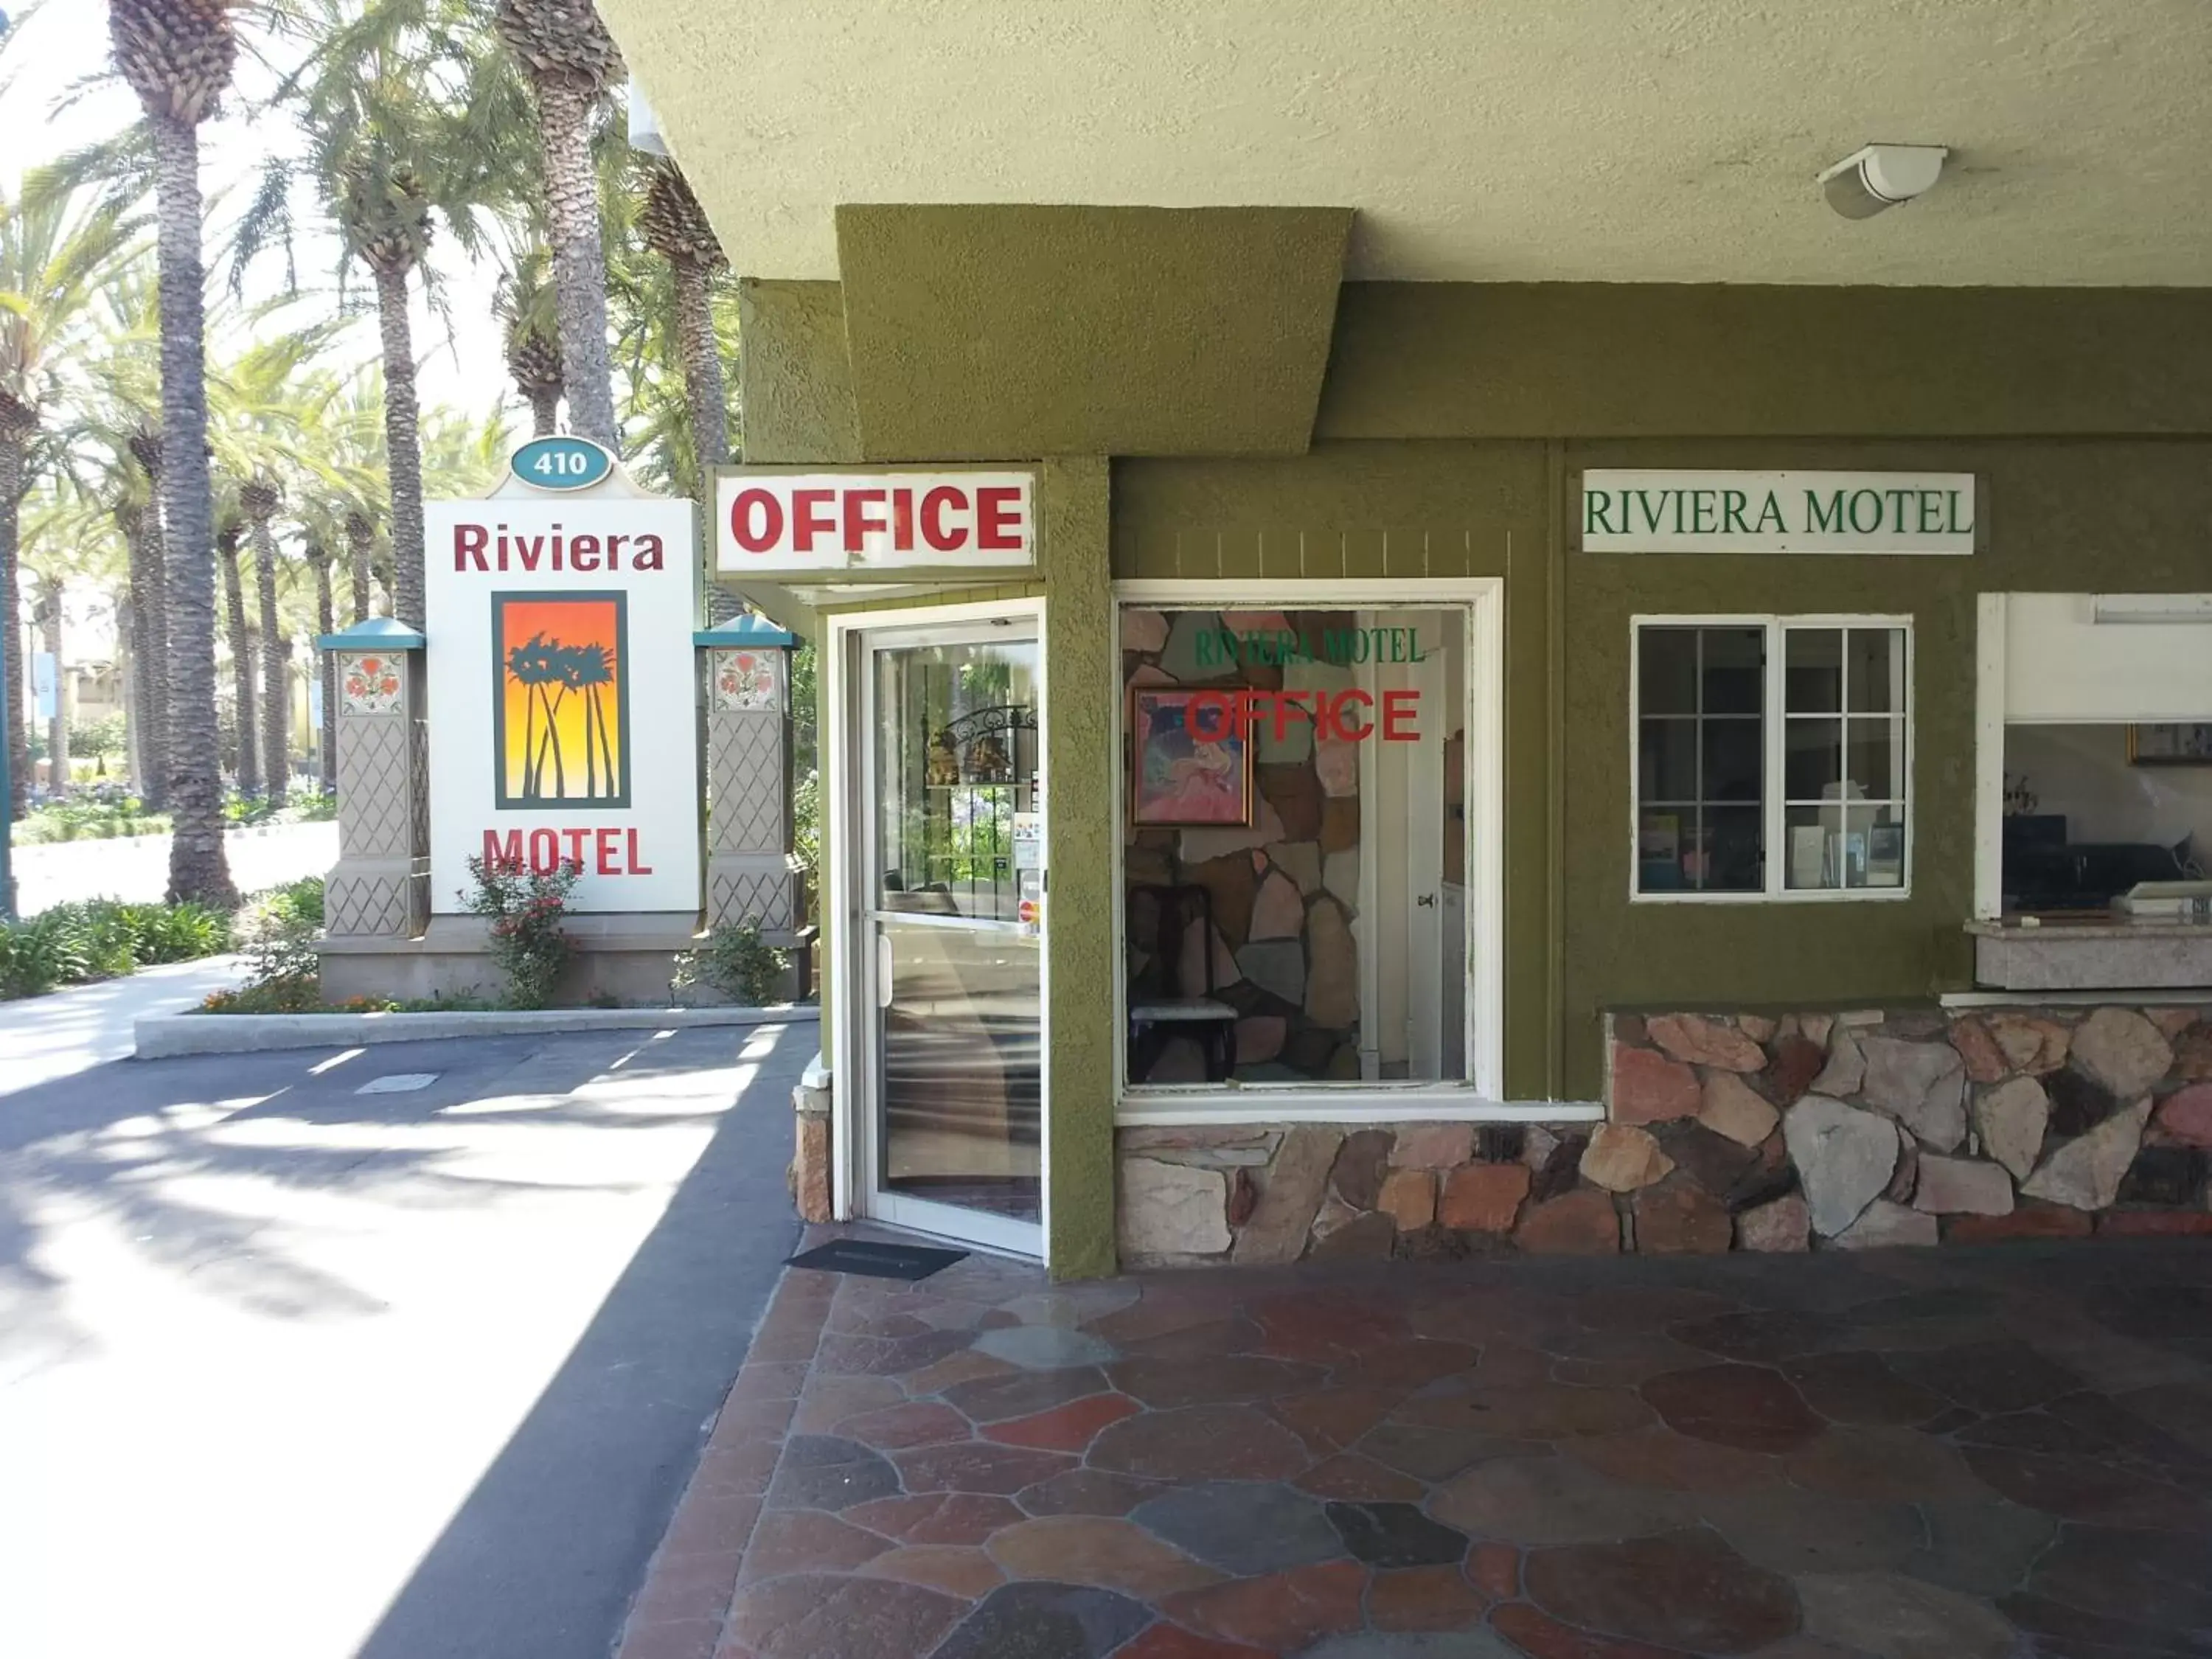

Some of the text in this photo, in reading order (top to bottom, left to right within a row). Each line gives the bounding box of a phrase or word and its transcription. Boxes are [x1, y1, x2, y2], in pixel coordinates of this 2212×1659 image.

[535, 452, 587, 475] 410
[731, 486, 1022, 553] OFFICE
[1584, 489, 1974, 534] RIVIERA MOTEL
[453, 524, 664, 571] Riviera
[1195, 627, 1427, 667] RIVIERA MOTEL
[1186, 689, 1421, 742] OFFICE
[483, 827, 653, 876] MOTEL
